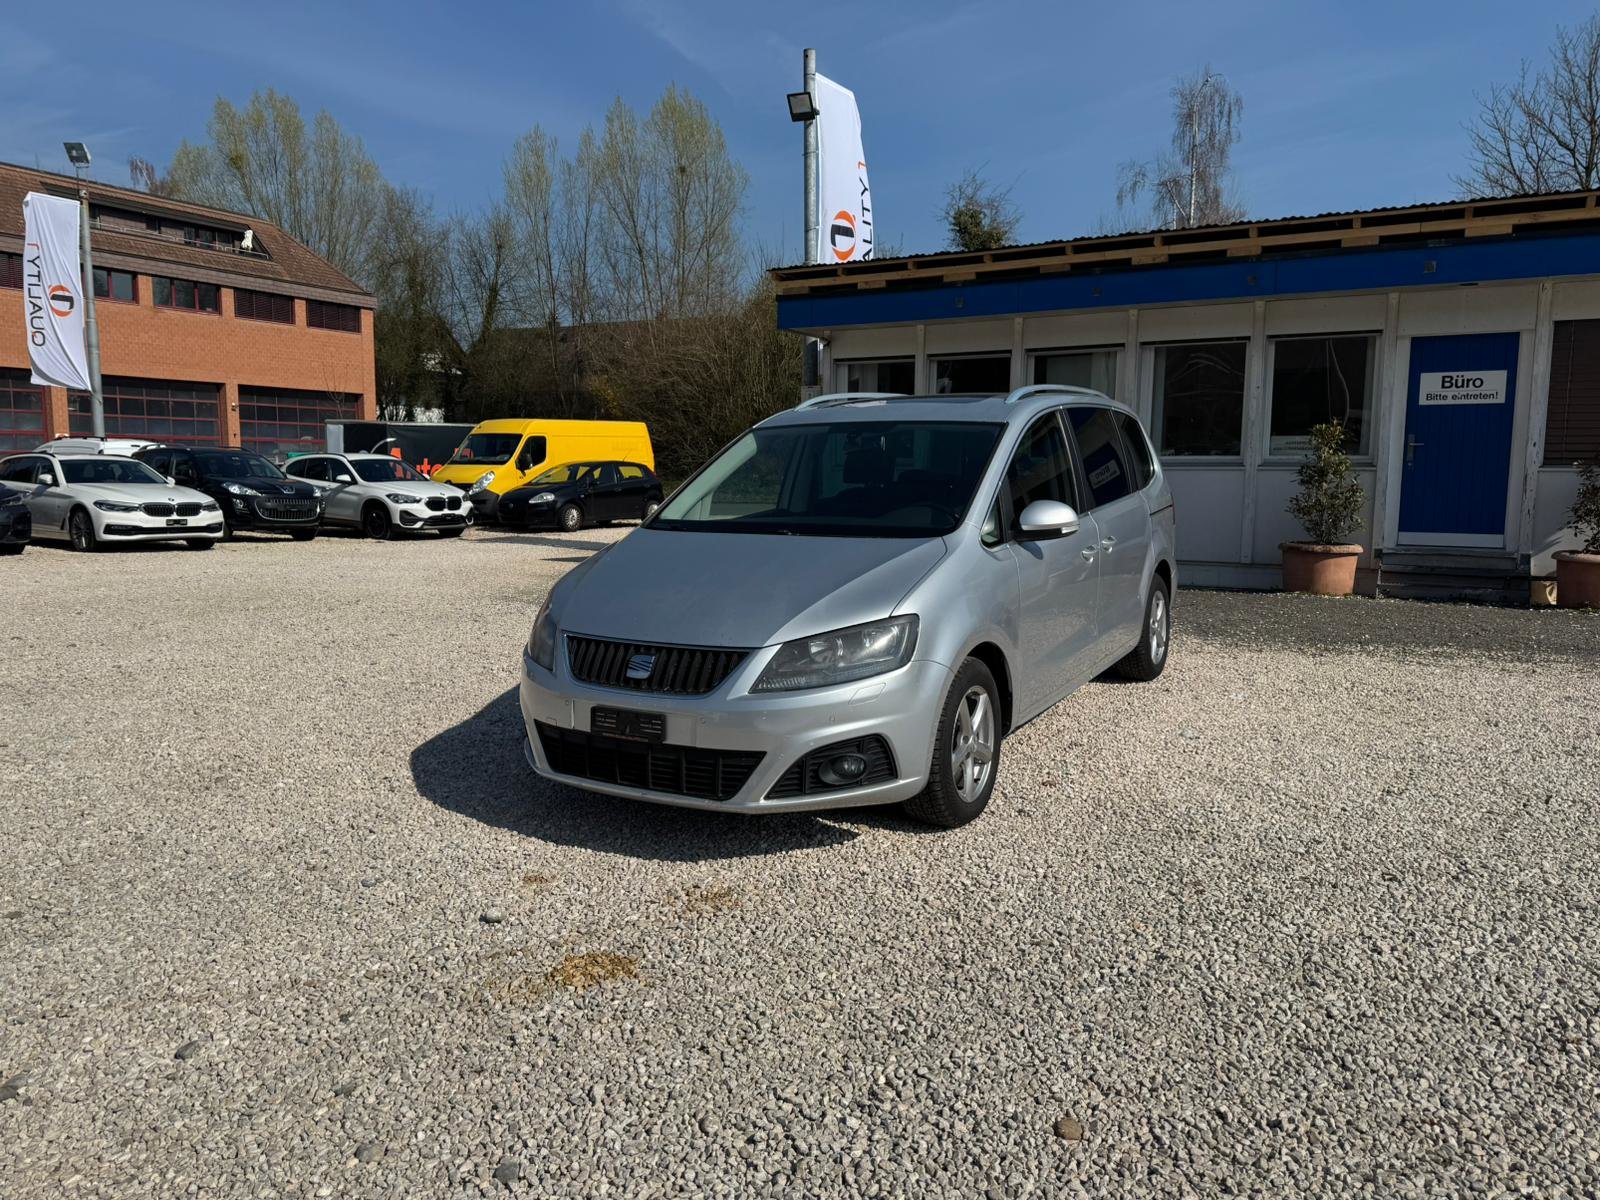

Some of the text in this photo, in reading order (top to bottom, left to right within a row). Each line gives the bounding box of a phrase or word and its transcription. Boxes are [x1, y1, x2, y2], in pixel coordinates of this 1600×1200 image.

[1440, 374, 1484, 389] Büro
[1425, 391, 1499, 401] Bitte eintreten!
